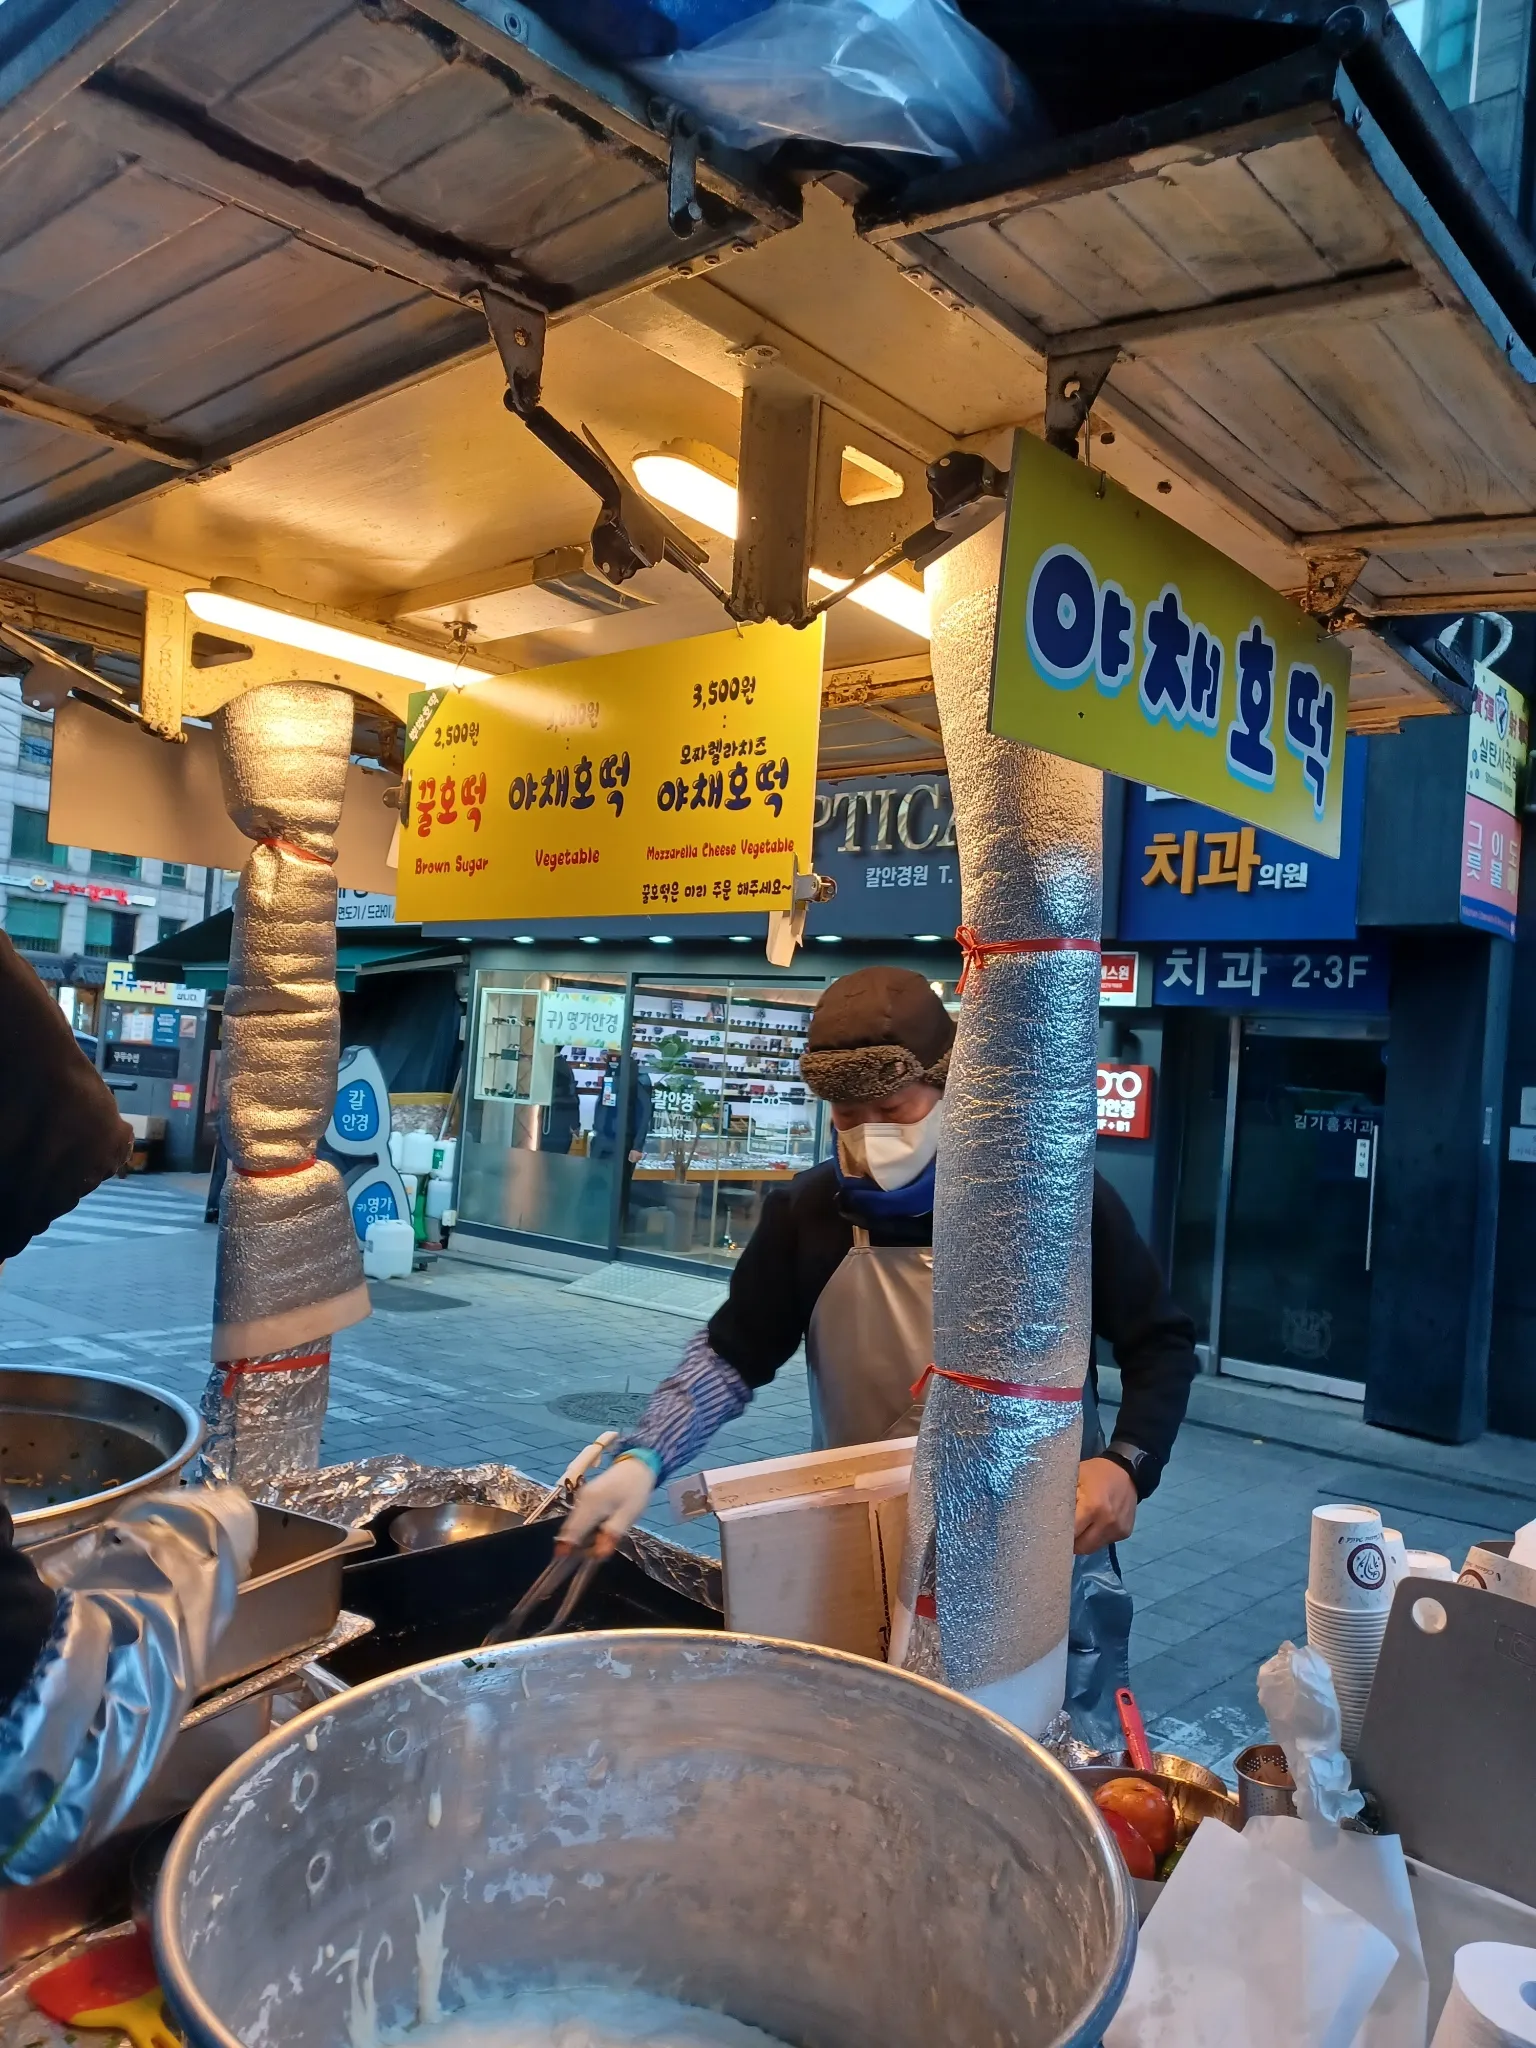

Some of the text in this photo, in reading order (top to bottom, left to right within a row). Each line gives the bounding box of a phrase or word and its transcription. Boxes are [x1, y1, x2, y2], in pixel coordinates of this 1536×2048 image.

[693, 675, 756, 710] 3,500원
[1027, 545, 1334, 818] 야채호떡
[433, 721, 480, 749] 2,500원
[679, 736, 767, 766] 모짜렐라치즈
[508, 750, 631, 819] 야채호떡
[656, 756, 790, 819] 야채호떡
[415, 771, 487, 838] 꿀호떡
[535, 848, 600, 872] Vegetable
[646, 836, 795, 861] Mozzarella Cheese Vegetable
[1140, 826, 1309, 895] 치과 의원
[415, 854, 489, 877] Brown Sugar
[865, 865, 928, 888] 칼안경원
[641, 881, 680, 904] 꿀호떡은
[684, 884, 707, 898] 미리
[712, 879, 732, 901] 주문
[566, 1011, 619, 1034] 명가안경
[348, 1089, 365, 1111] 칼
[651, 1088, 694, 1113] 칼안경
[341, 1113, 370, 1132] 안경
[367, 1196, 393, 1214] 명가
